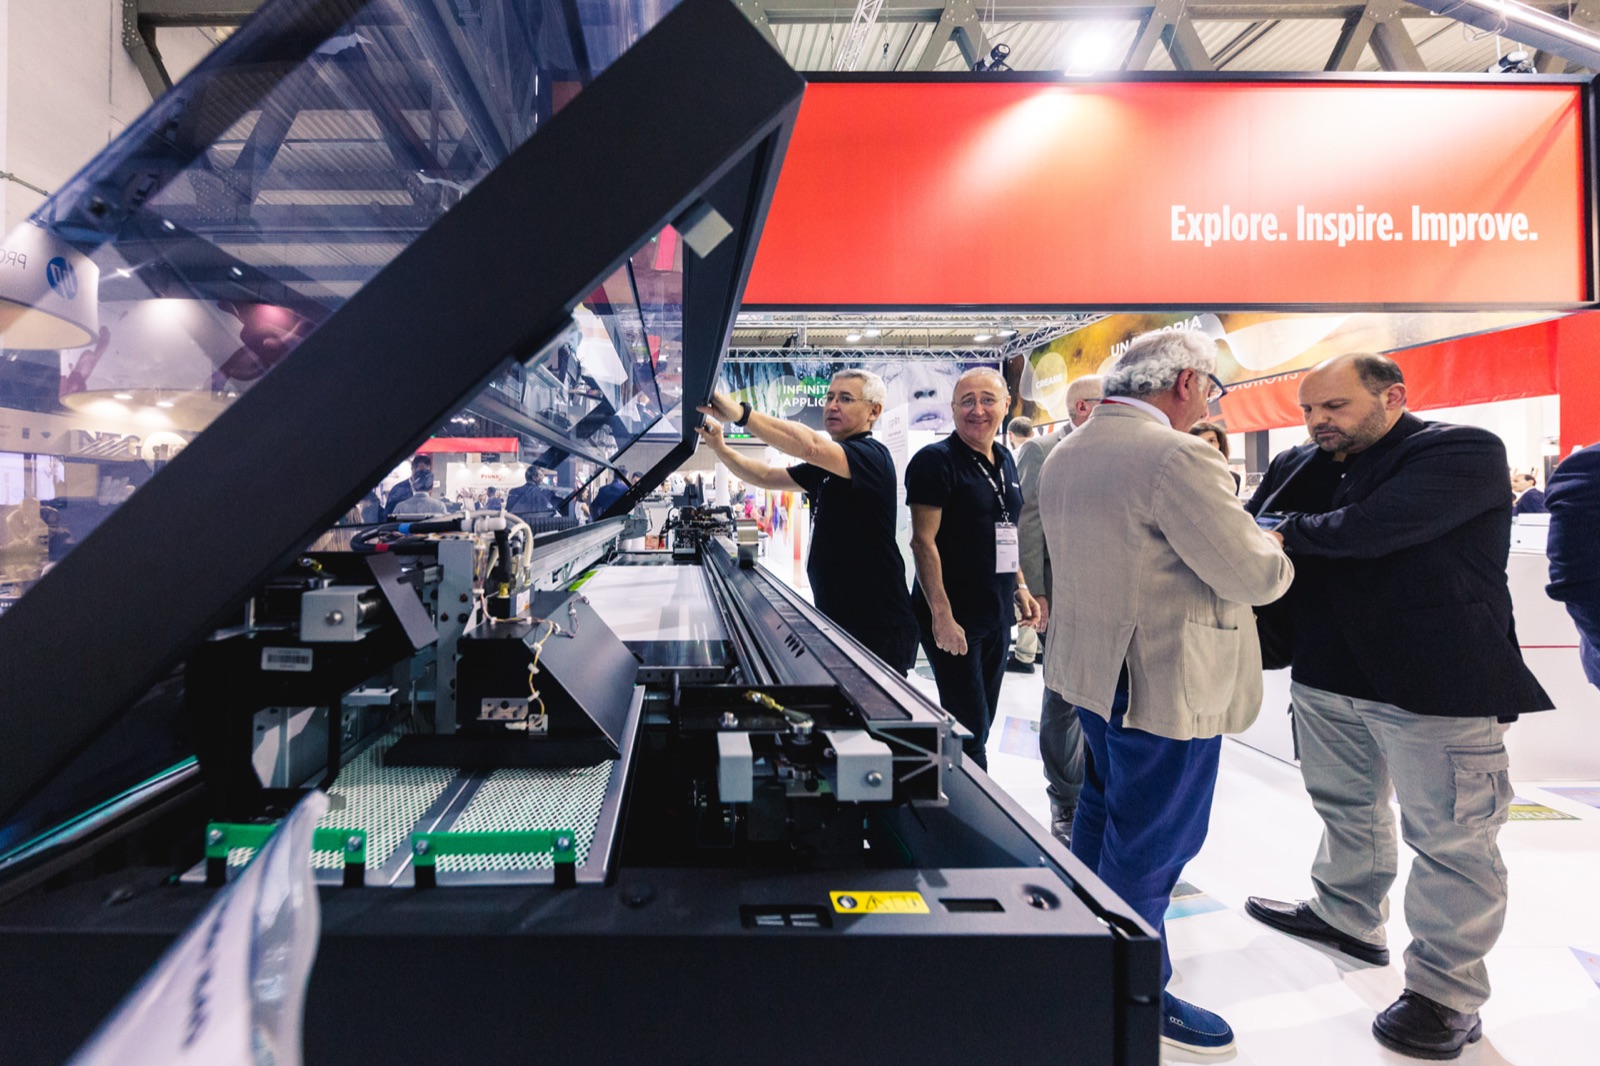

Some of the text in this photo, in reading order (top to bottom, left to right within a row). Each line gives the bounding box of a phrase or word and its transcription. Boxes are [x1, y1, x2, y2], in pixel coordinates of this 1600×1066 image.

[1171, 205, 1538, 247] Explore. Inspire. Improve.
[783, 384, 831, 395] INFINIT
